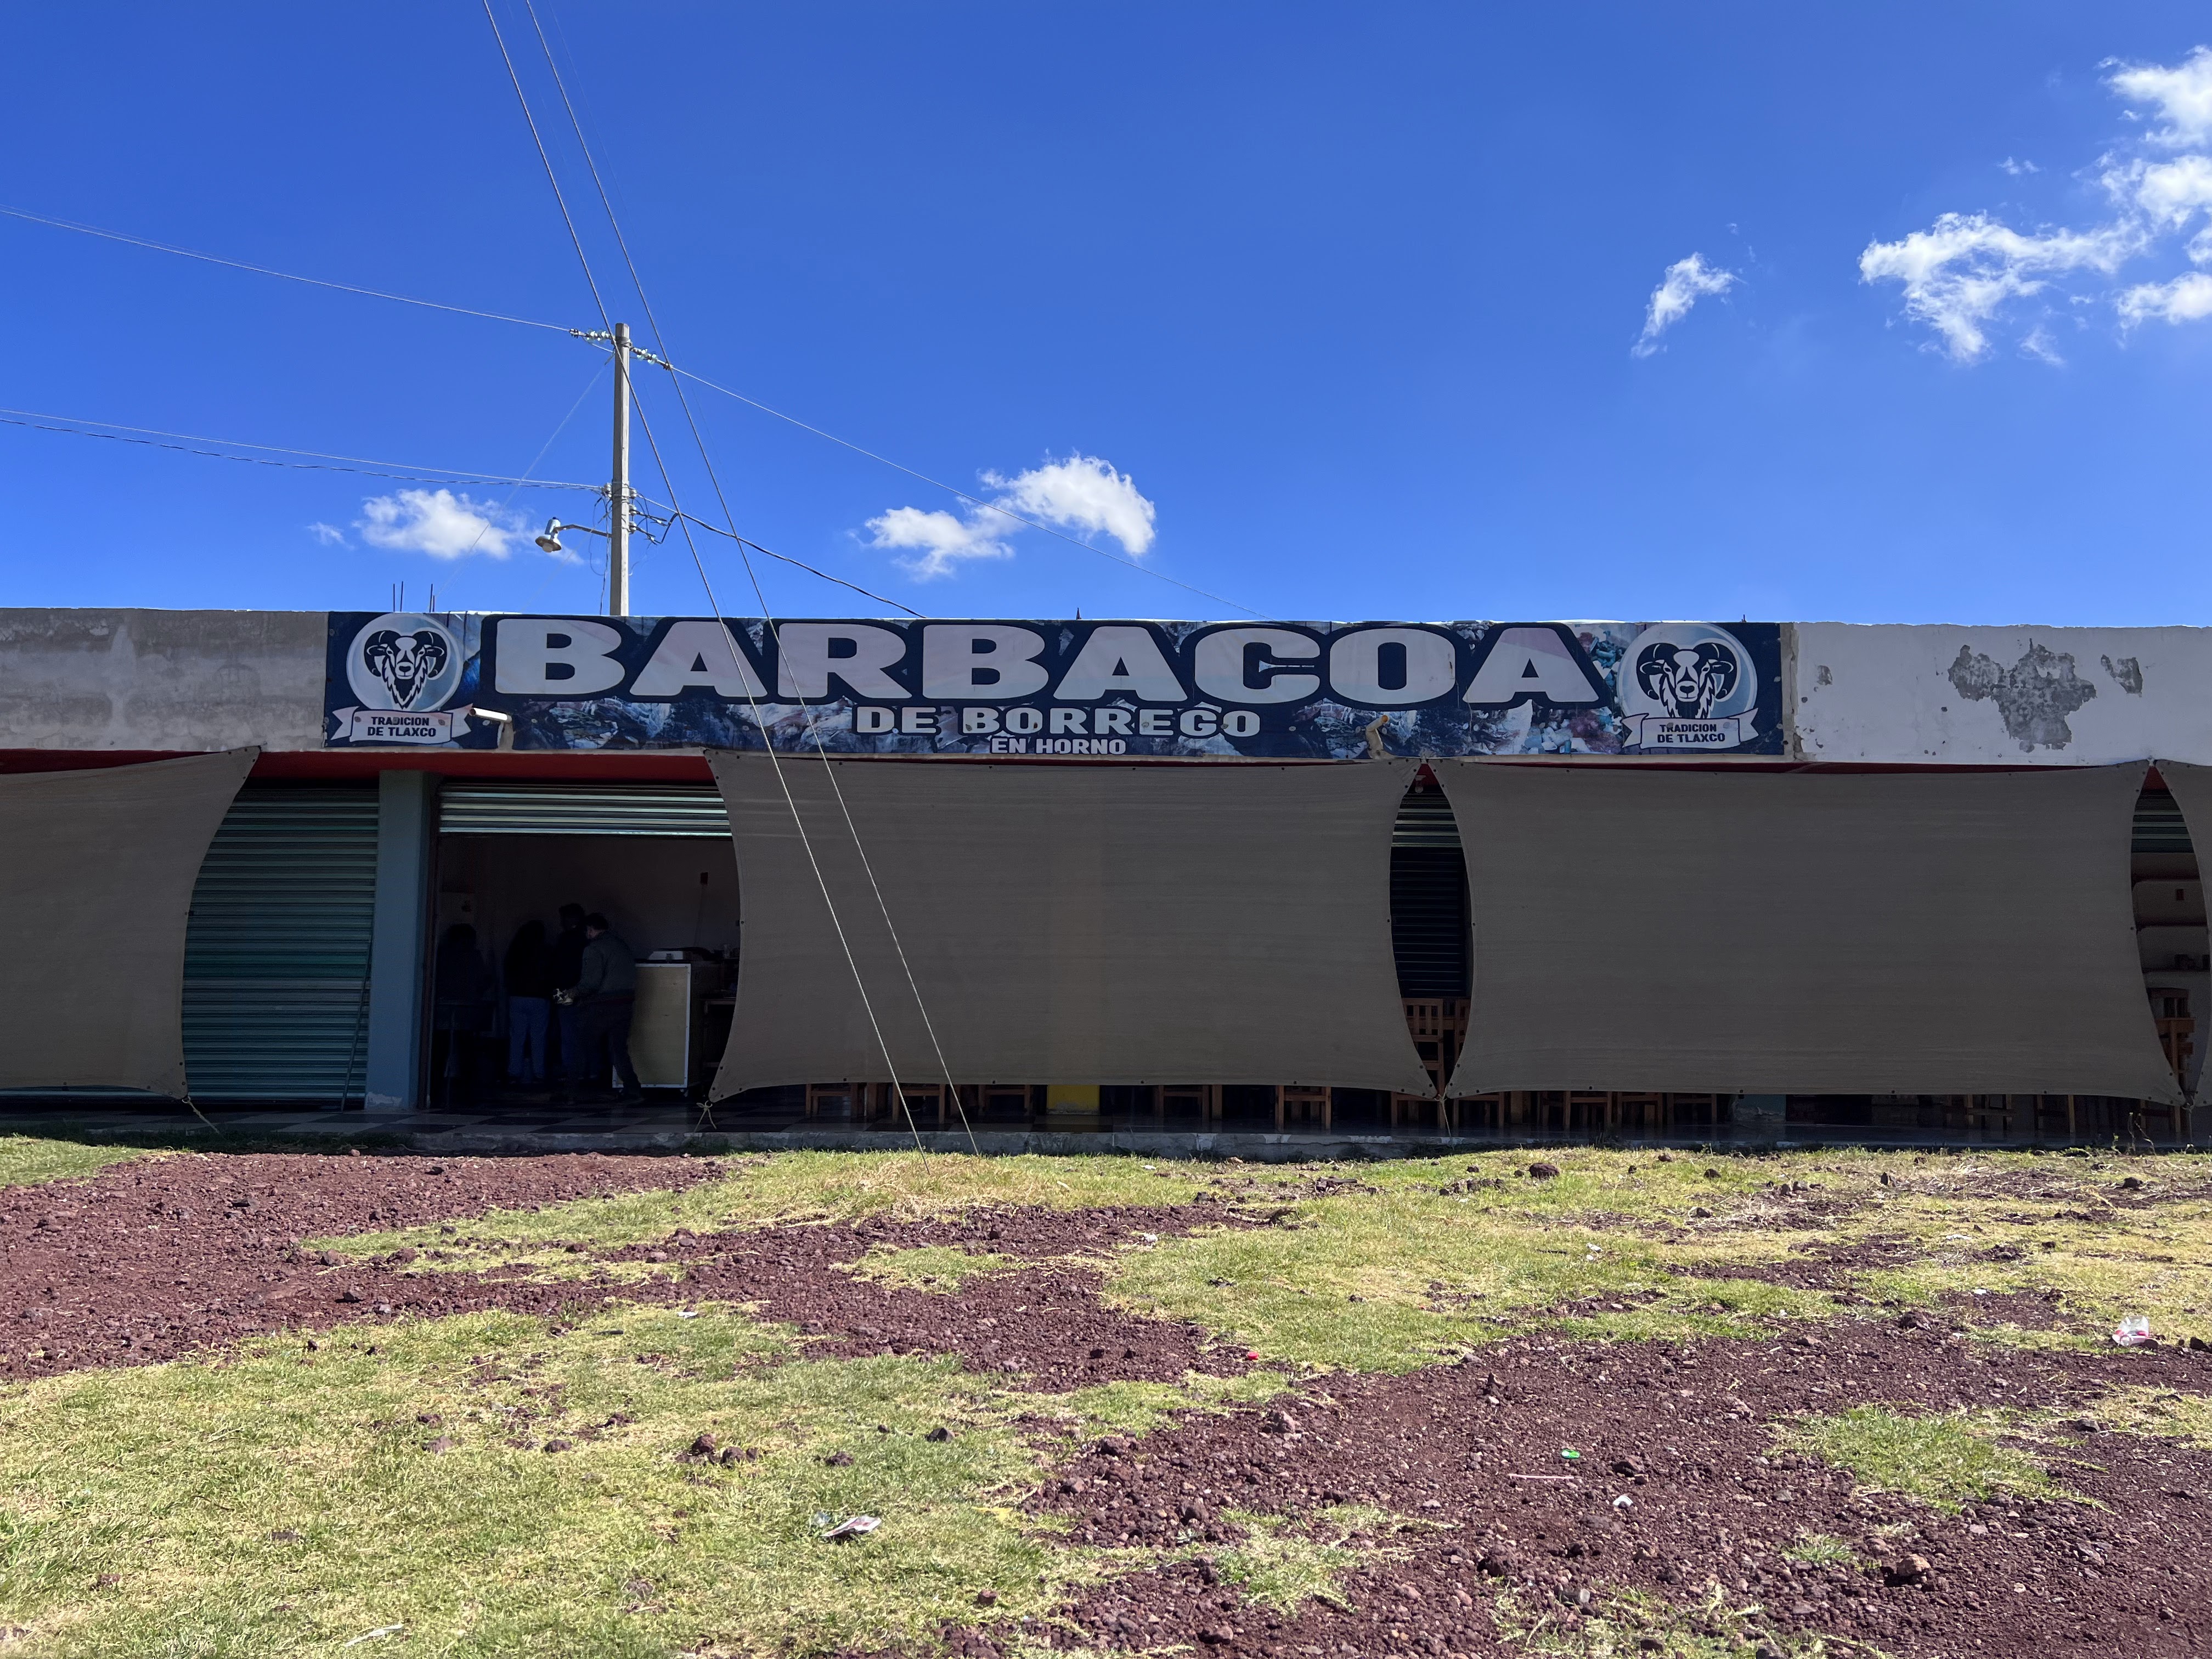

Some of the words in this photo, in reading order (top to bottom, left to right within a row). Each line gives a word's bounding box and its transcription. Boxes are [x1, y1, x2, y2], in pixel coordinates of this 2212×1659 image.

[495, 618, 1599, 705] BARBACOA
[856, 707, 936, 734] DE
[962, 707, 1261, 737] BORREGO
[368, 727, 384, 736] DE
[388, 727, 437, 737] TLAXCO
[1657, 734, 1673, 743] DE
[1677, 733, 1725, 742] TLAXCO
[992, 739, 1026, 754] EN
[1036, 739, 1126, 755] HORNO
